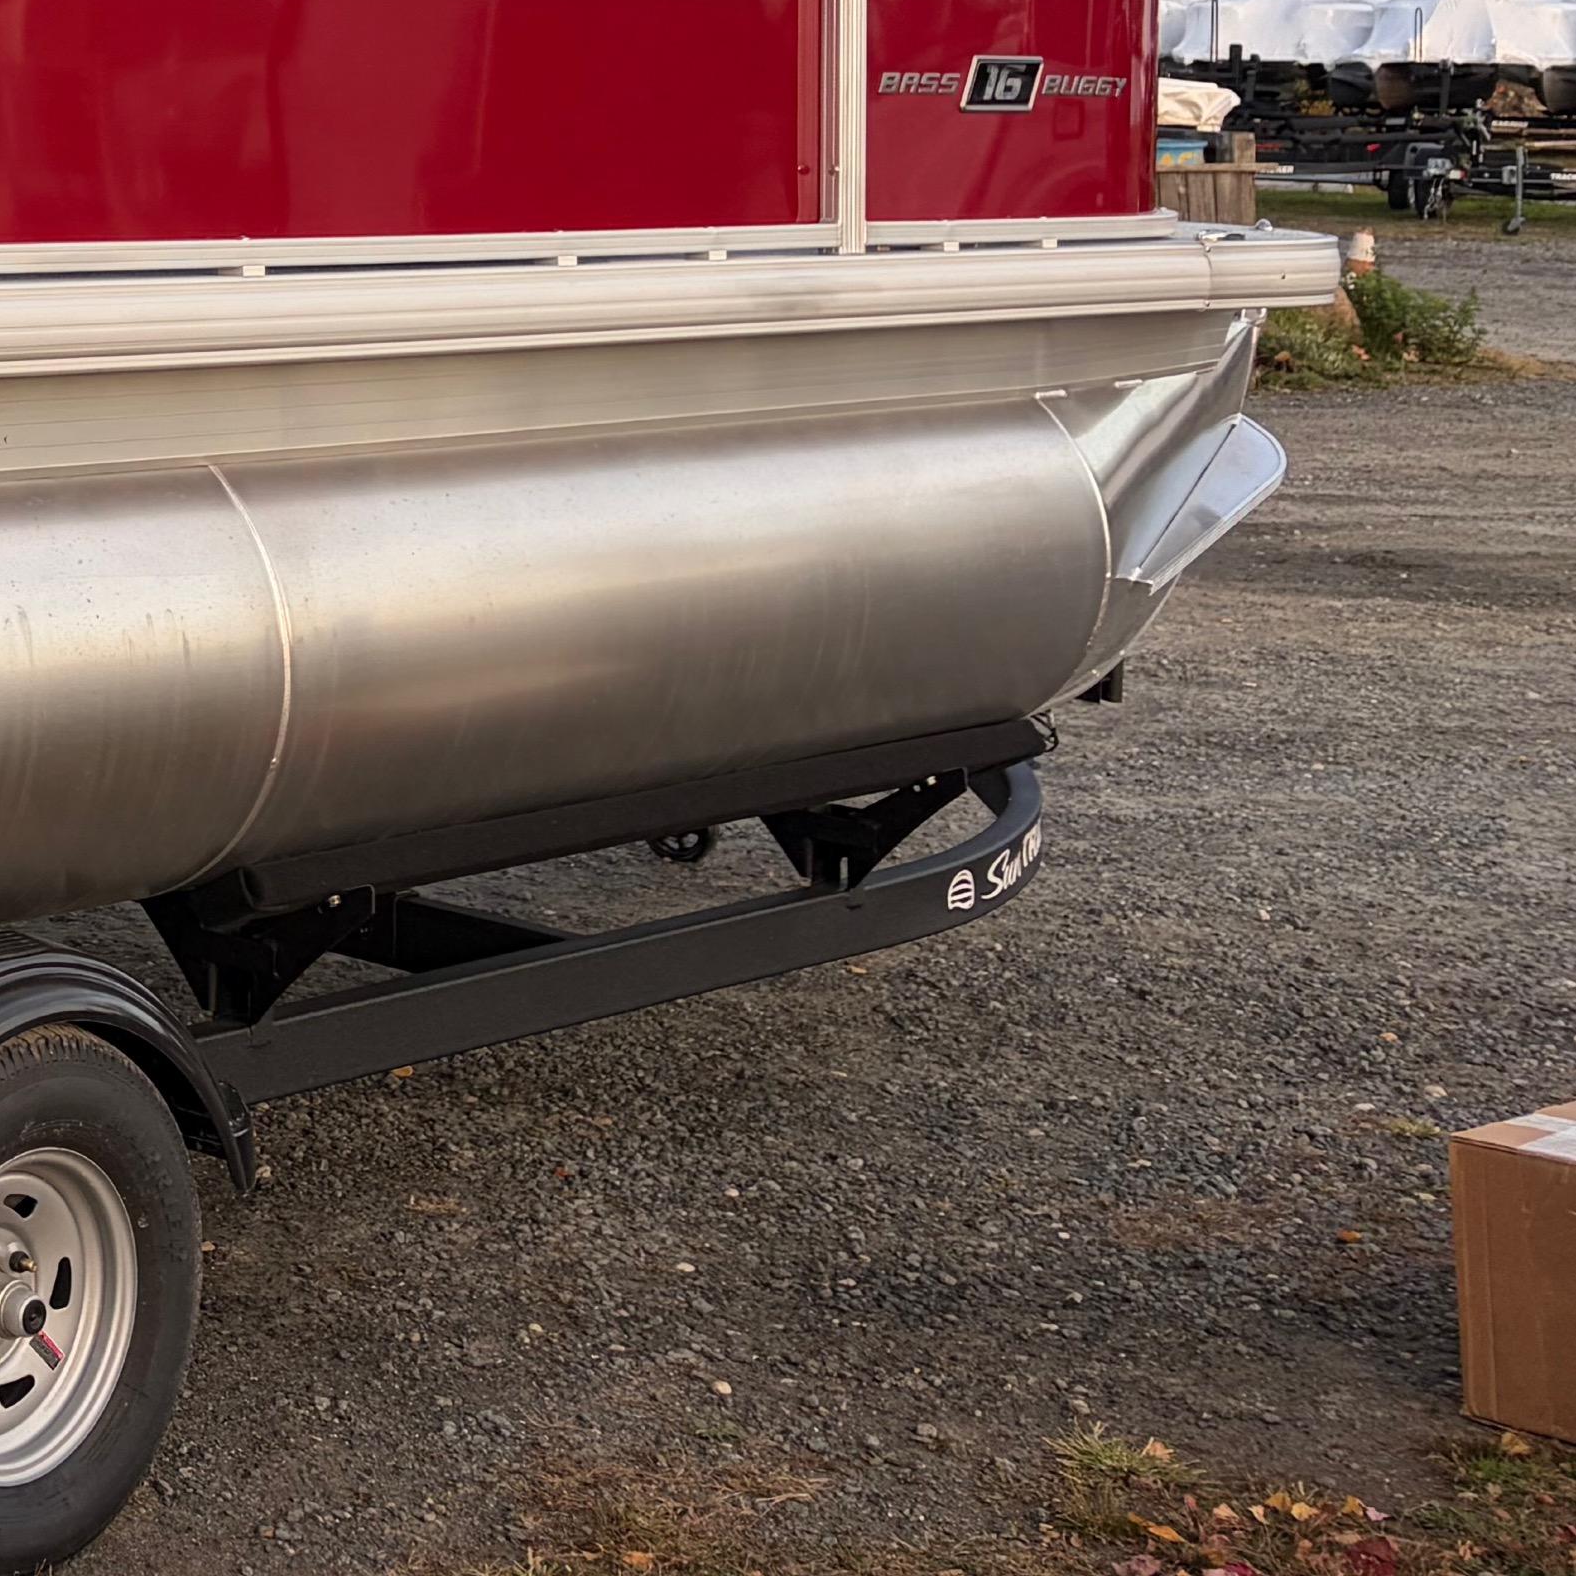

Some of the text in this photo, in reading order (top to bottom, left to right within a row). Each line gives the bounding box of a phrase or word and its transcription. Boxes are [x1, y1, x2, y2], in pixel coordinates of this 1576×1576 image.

[878, 63, 1127, 101] BASS 16 BUGGY
